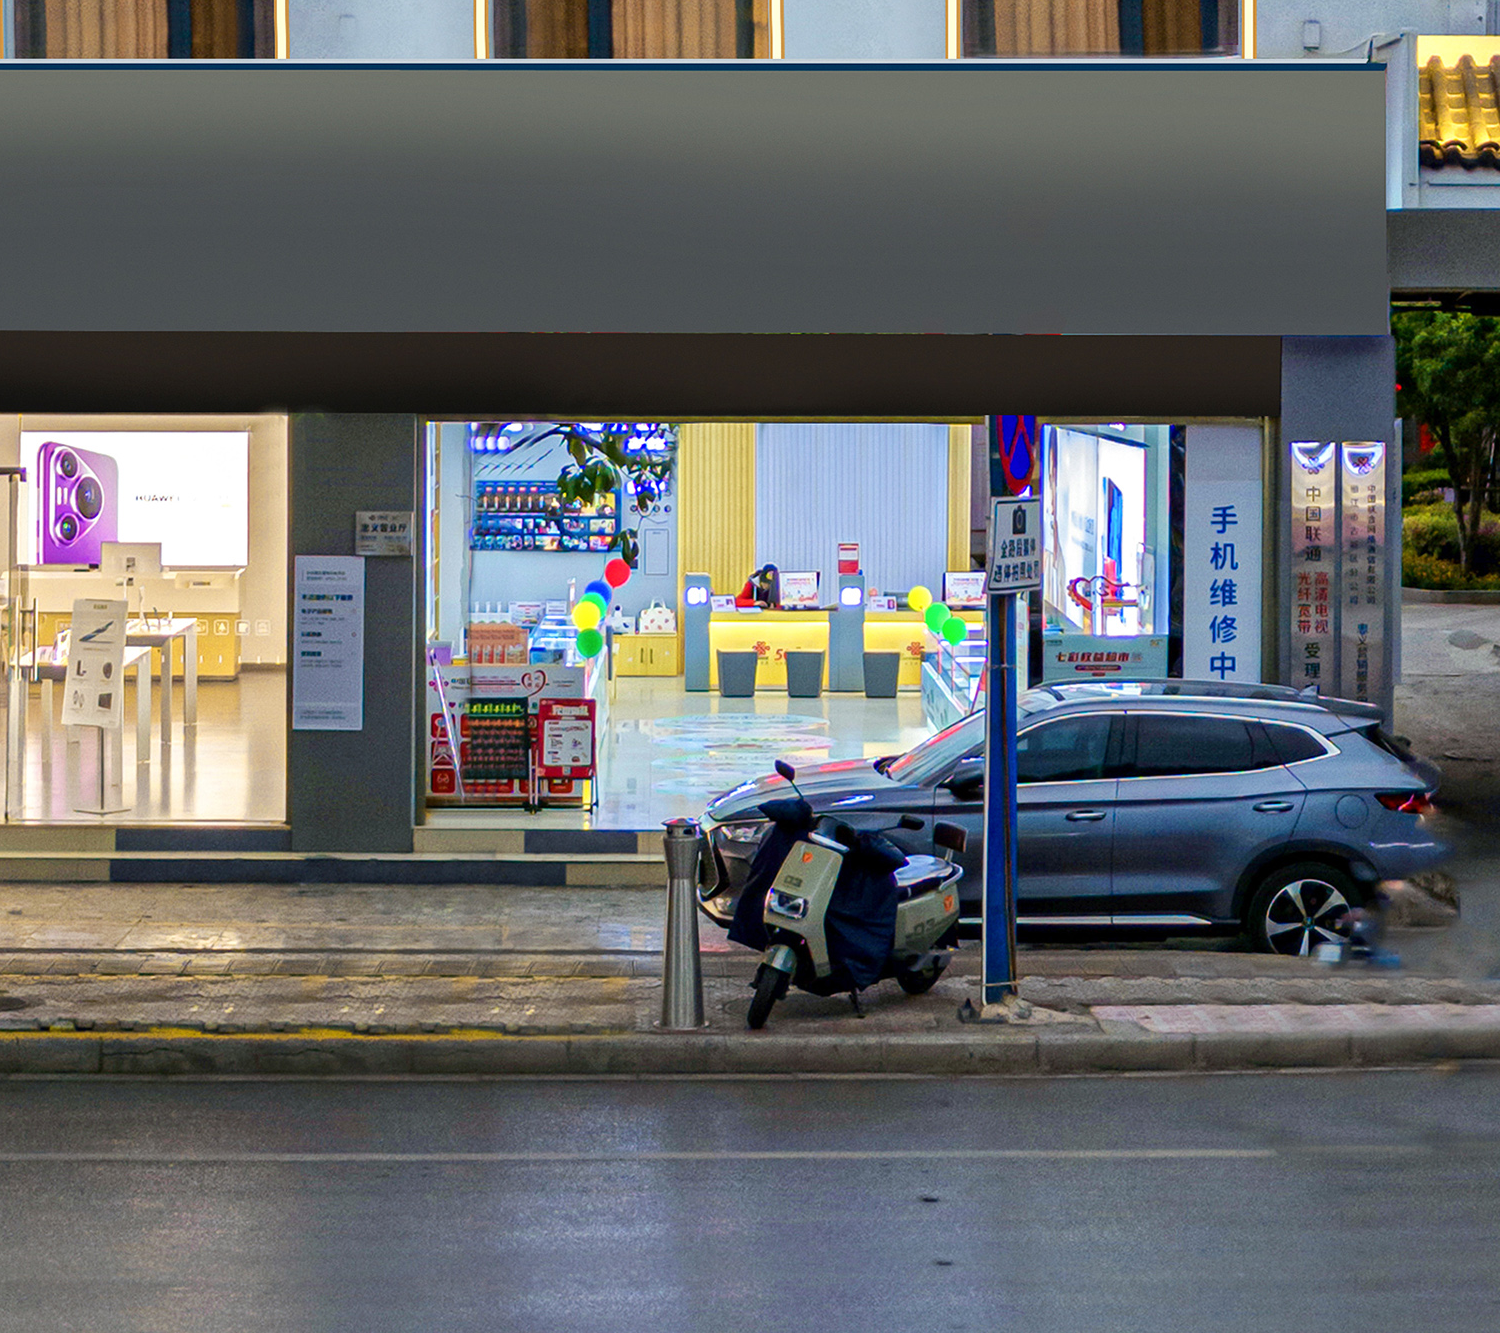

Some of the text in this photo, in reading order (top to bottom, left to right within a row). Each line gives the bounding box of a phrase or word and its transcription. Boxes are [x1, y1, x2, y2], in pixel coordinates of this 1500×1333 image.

[1305, 486, 1322, 563] 中国联通
[1210, 505, 1239, 680] 手机维修中
[1298, 572, 1312, 633] 光纤宽带
[1315, 572, 1329, 633] 高清电视
[1304, 642, 1321, 694] 受理
